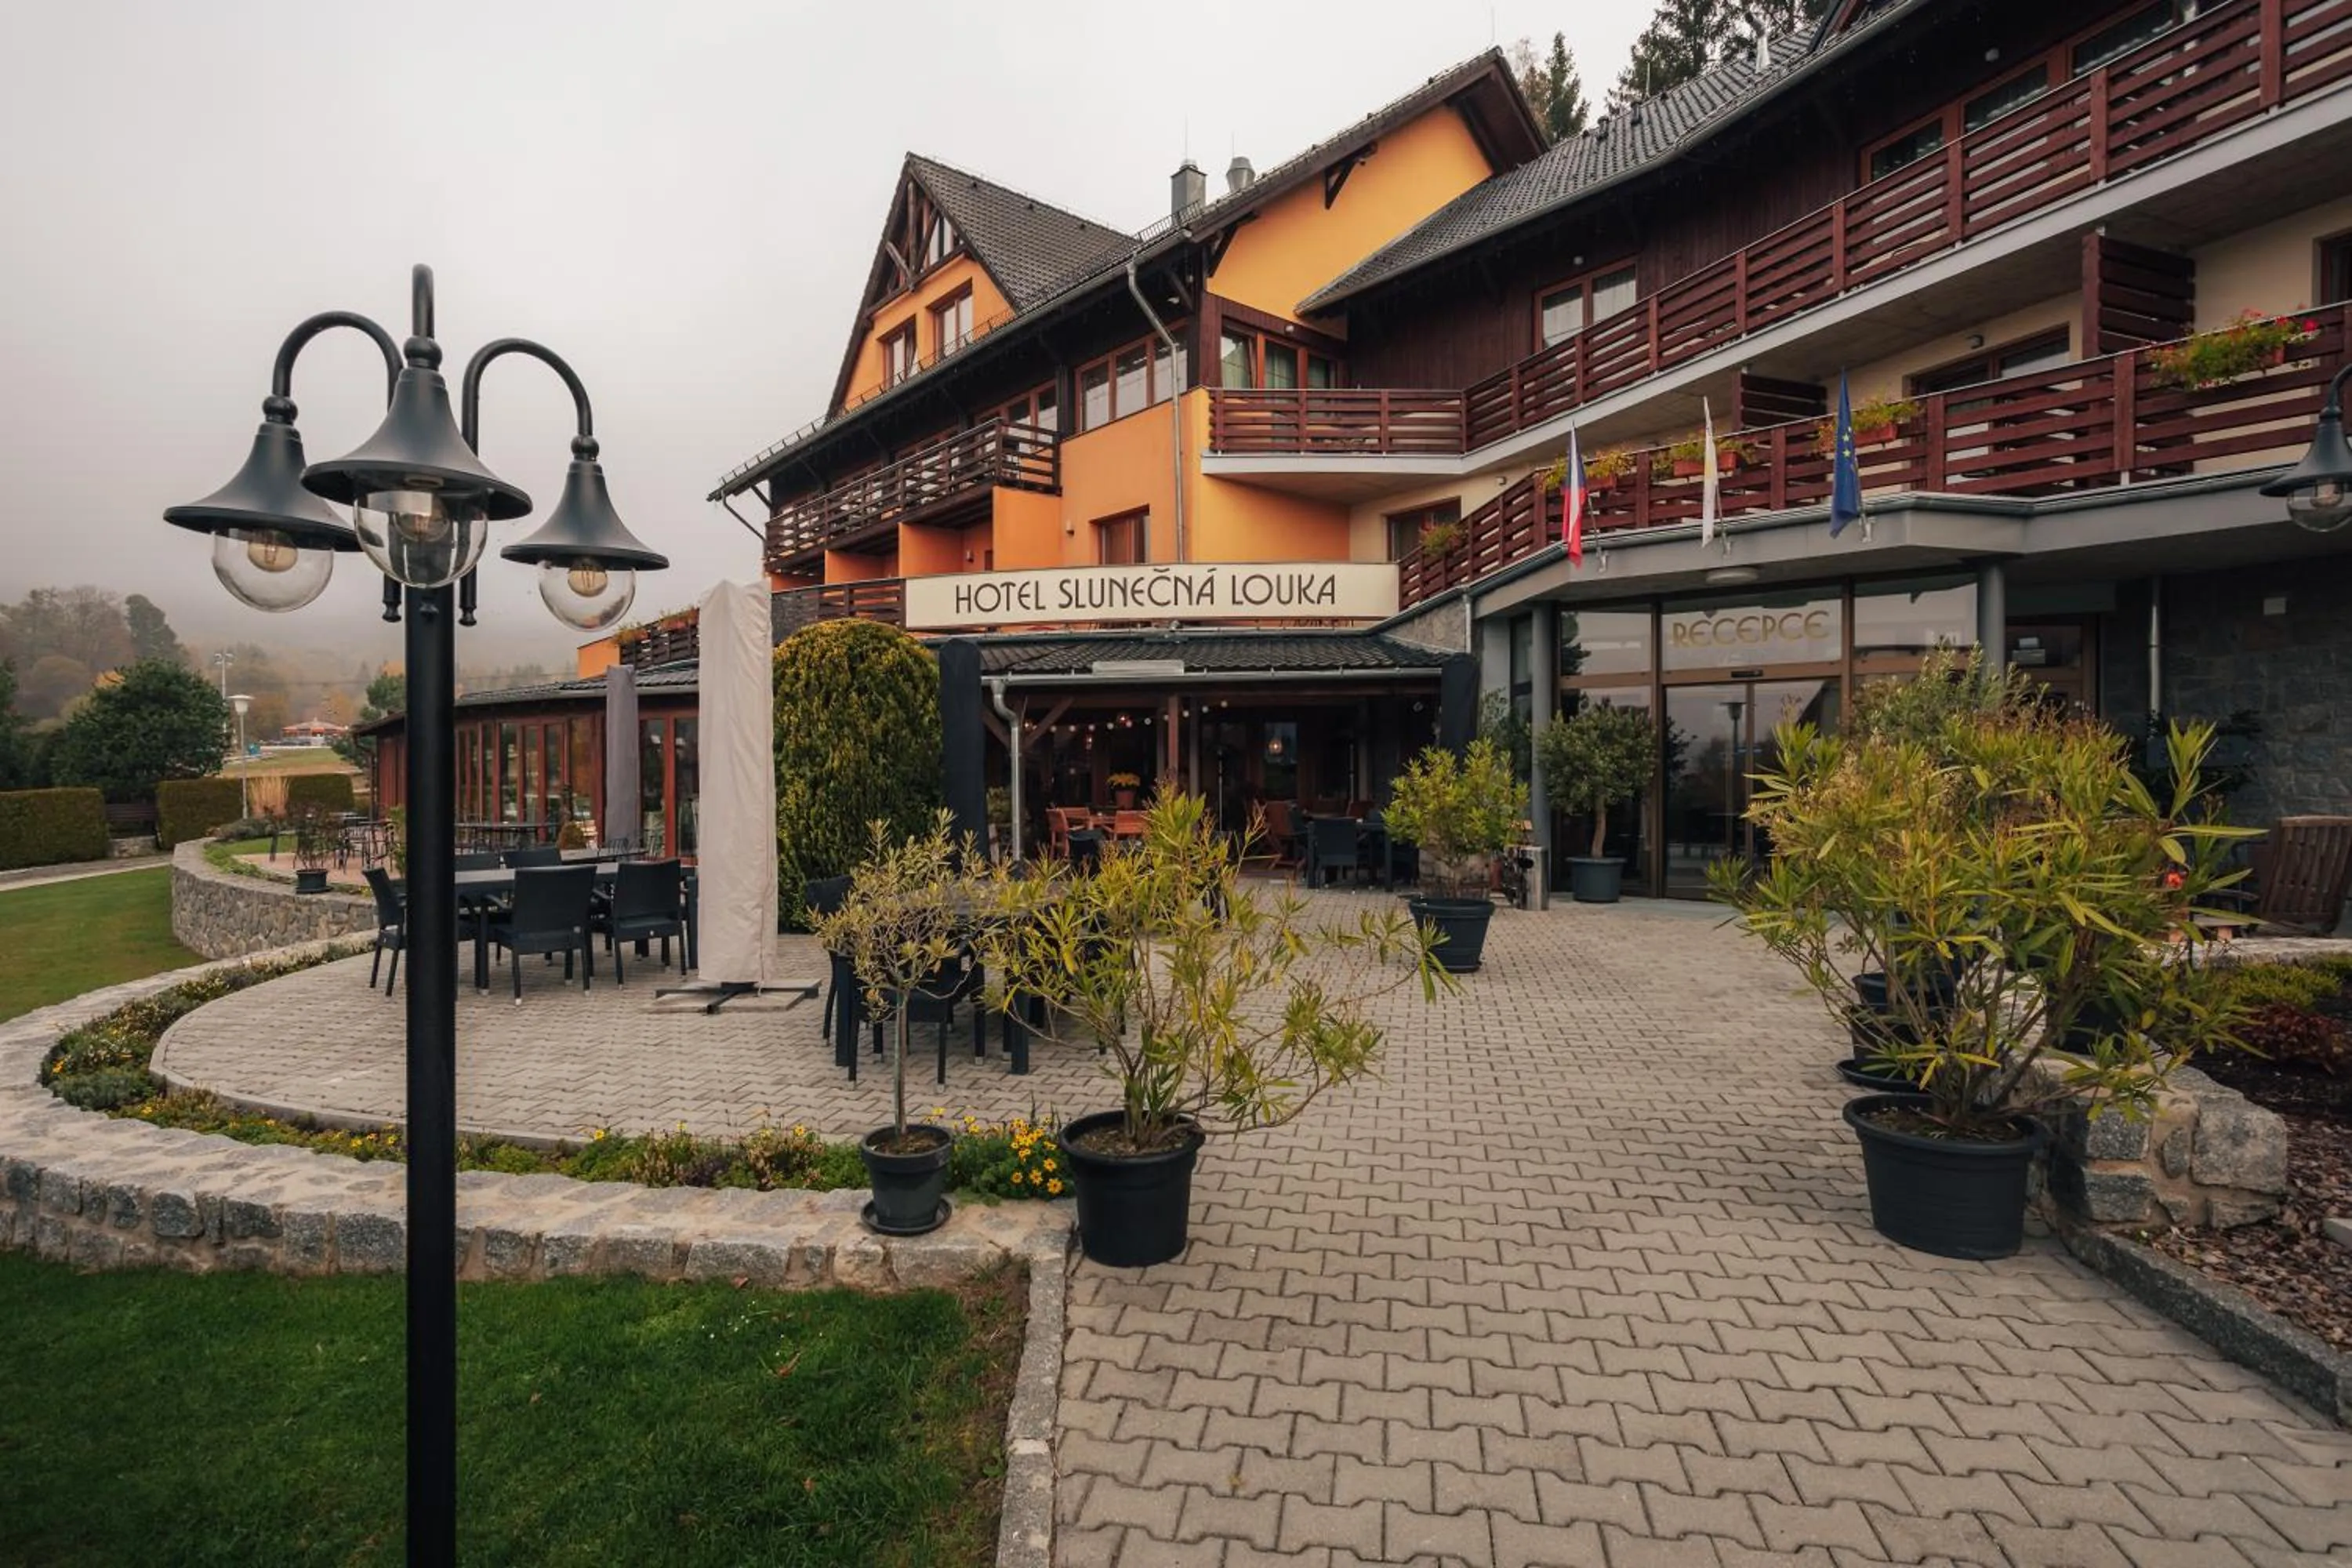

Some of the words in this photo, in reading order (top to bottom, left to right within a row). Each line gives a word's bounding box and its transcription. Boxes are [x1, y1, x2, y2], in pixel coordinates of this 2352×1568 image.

[956, 580, 1047, 614] HOTEL
[1058, 568, 1218, 609] SLUNEČNÁ
[1231, 574, 1335, 605] LOUKA
[1671, 610, 1830, 648] RECEPCE
